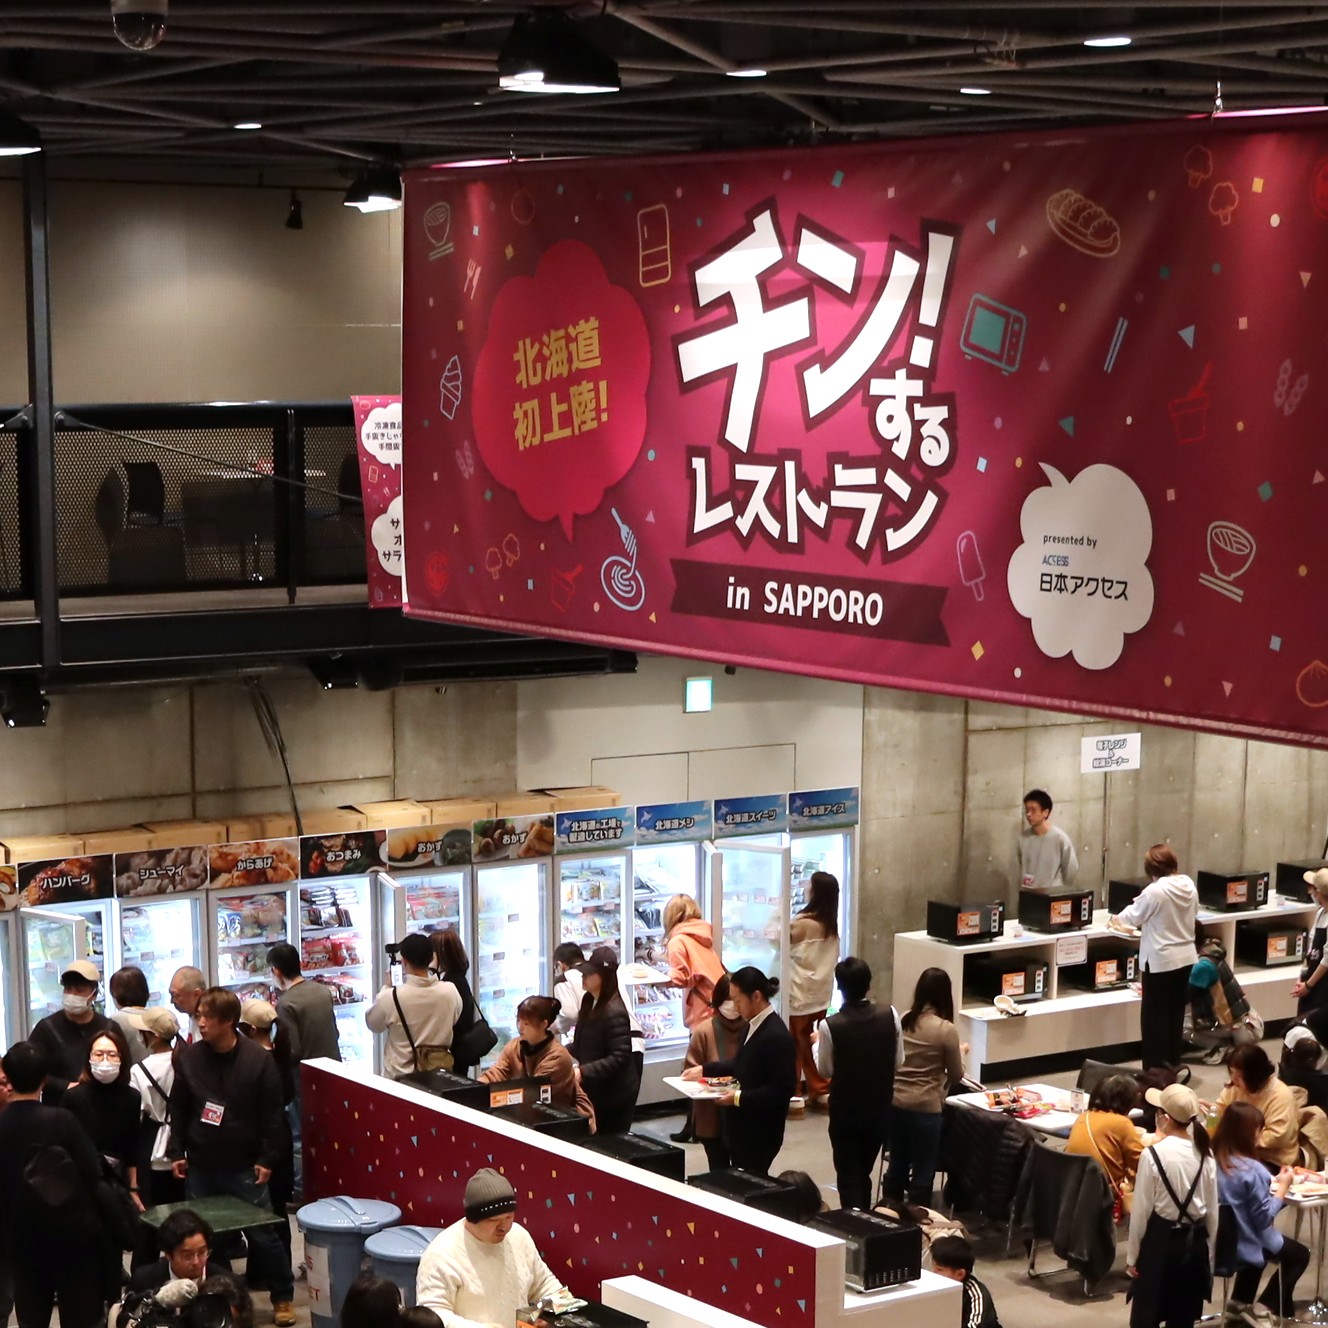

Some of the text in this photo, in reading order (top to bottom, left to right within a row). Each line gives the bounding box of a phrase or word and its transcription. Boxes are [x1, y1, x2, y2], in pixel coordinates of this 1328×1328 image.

[677, 209, 954, 453] チン!
[513, 316, 601, 389] 北海道
[513, 380, 608, 451] 初上陸!
[869, 368, 951, 467] する
[692, 456, 938, 551] レストラン
[1043, 534, 1097, 549] presented by
[1039, 572, 1128, 601] 日本アクセス
[726, 576, 884, 626] in SAPPORO
[725, 809, 777, 826] 北海道スイーツ
[802, 803, 846, 817] 北海道アイス
[654, 817, 695, 832] 北海道メシ
[417, 840, 443, 853] おかず
[502, 832, 528, 845] おかず
[236, 856, 273, 871] からあげ
[326, 849, 362, 863] おつまみ
[42, 873, 91, 890] ハンバーグ
